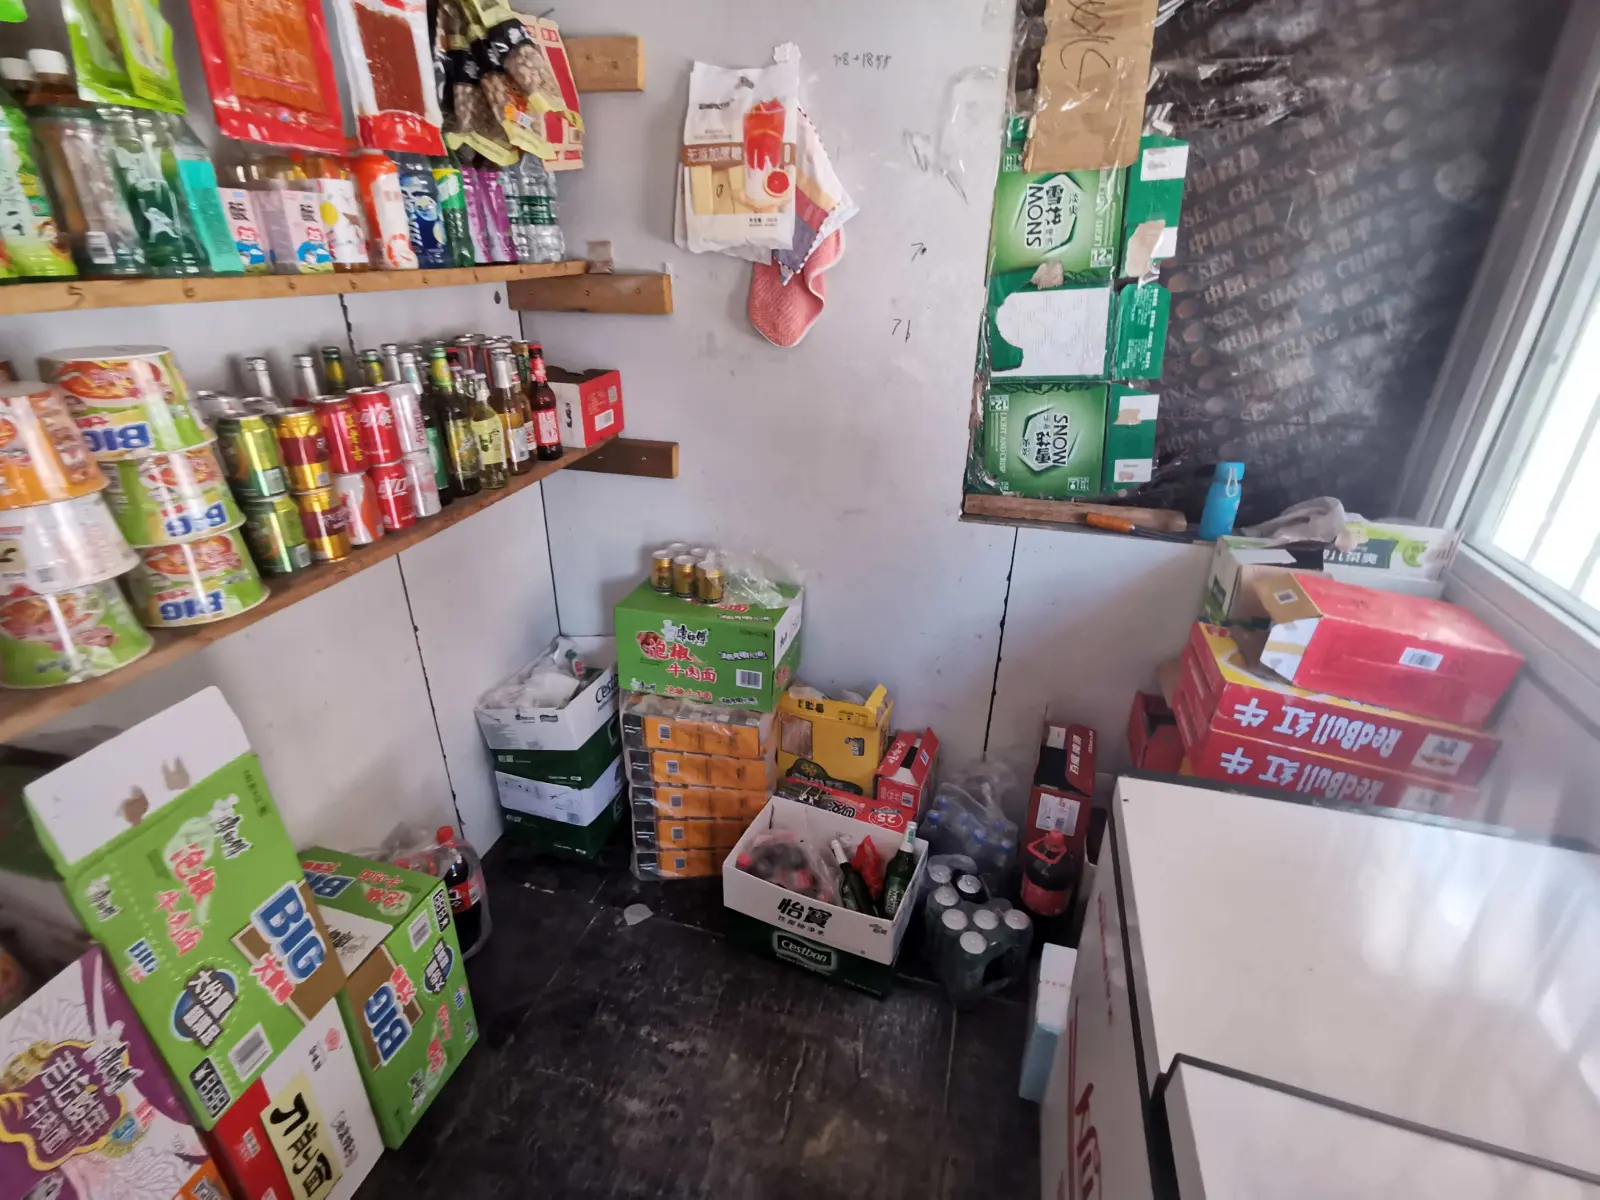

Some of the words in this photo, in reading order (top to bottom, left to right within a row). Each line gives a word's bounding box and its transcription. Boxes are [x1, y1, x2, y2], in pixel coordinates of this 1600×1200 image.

[1026, 185, 1045, 248] SNOW
[1200, 252, 1237, 279] SEN
[1258, 268, 1328, 312] CHANG
[1053, 414, 1069, 466] SNOW
[643, 638, 692, 661] 泡椒
[666, 663, 717, 684] 牛肉面
[1233, 697, 1317, 738] 红牛
[1311, 712, 1402, 758] RedBull
[1219, 746, 1301, 784] 红牛
[1297, 763, 1385, 803] RedBull
[254, 882, 326, 983] BIG
[777, 897, 833, 929] 怡寶
[780, 938, 828, 964] Cestbon
[188, 969, 237, 1019] 大份量
[184, 1004, 224, 1048] 超满足
[364, 982, 412, 1067] BIG
[40, 1050, 112, 1141] 老坛酸菜
[24, 1094, 72, 1155] 牛肉面
[269, 1091, 333, 1198] 刀削面
